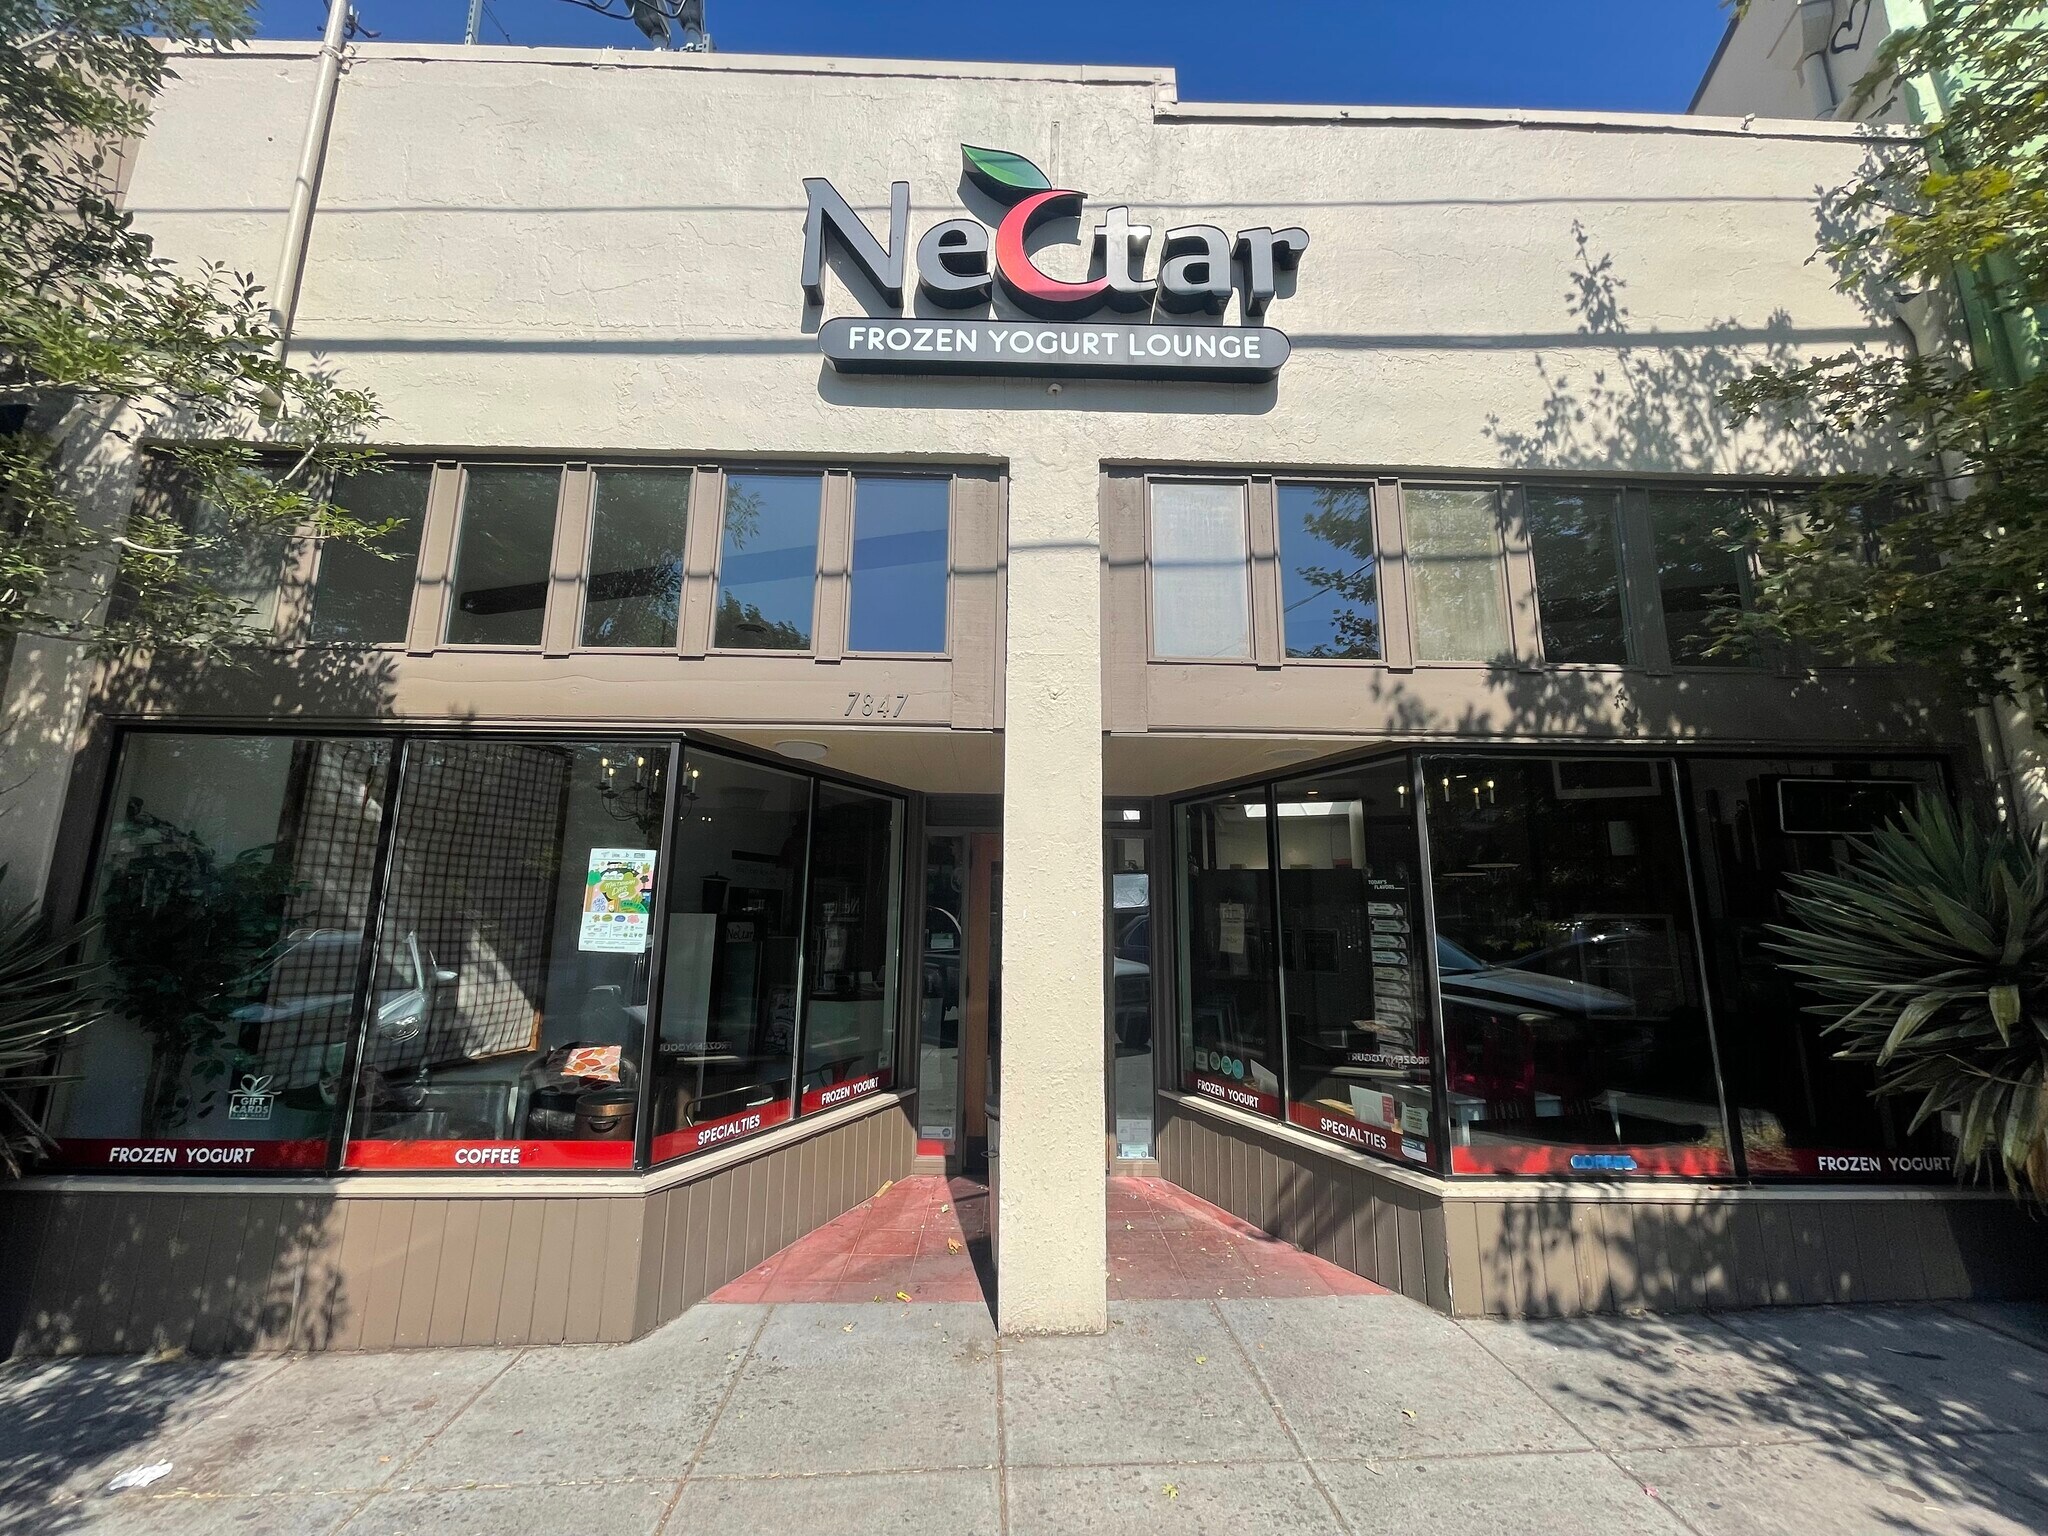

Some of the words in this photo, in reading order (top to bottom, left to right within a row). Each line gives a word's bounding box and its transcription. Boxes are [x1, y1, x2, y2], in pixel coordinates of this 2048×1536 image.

[848, 326, 978, 353] FROZEN
[988, 330, 1119, 356] YOGURT
[1129, 333, 1261, 360] LOUNGE
[844, 692, 909, 718] 7847
[240, 1097, 265, 1106] GIFT
[821, 1085, 851, 1106] FROZEN
[852, 1076, 879, 1095] YOGURT
[1197, 1078, 1225, 1098] FROZEN
[1227, 1088, 1259, 1109] YOGURT
[232, 1105, 269, 1114] CARDS
[697, 1114, 761, 1146] SPECIALTIES
[1320, 1117, 1387, 1150] SPECIALTIES
[109, 1147, 177, 1163] FROZEN
[186, 1147, 255, 1163] YOGURT
[454, 1148, 521, 1164] COFFEE
[1817, 1156, 1882, 1172] FROZEN
[1887, 1157, 1951, 1172] YOGURT
